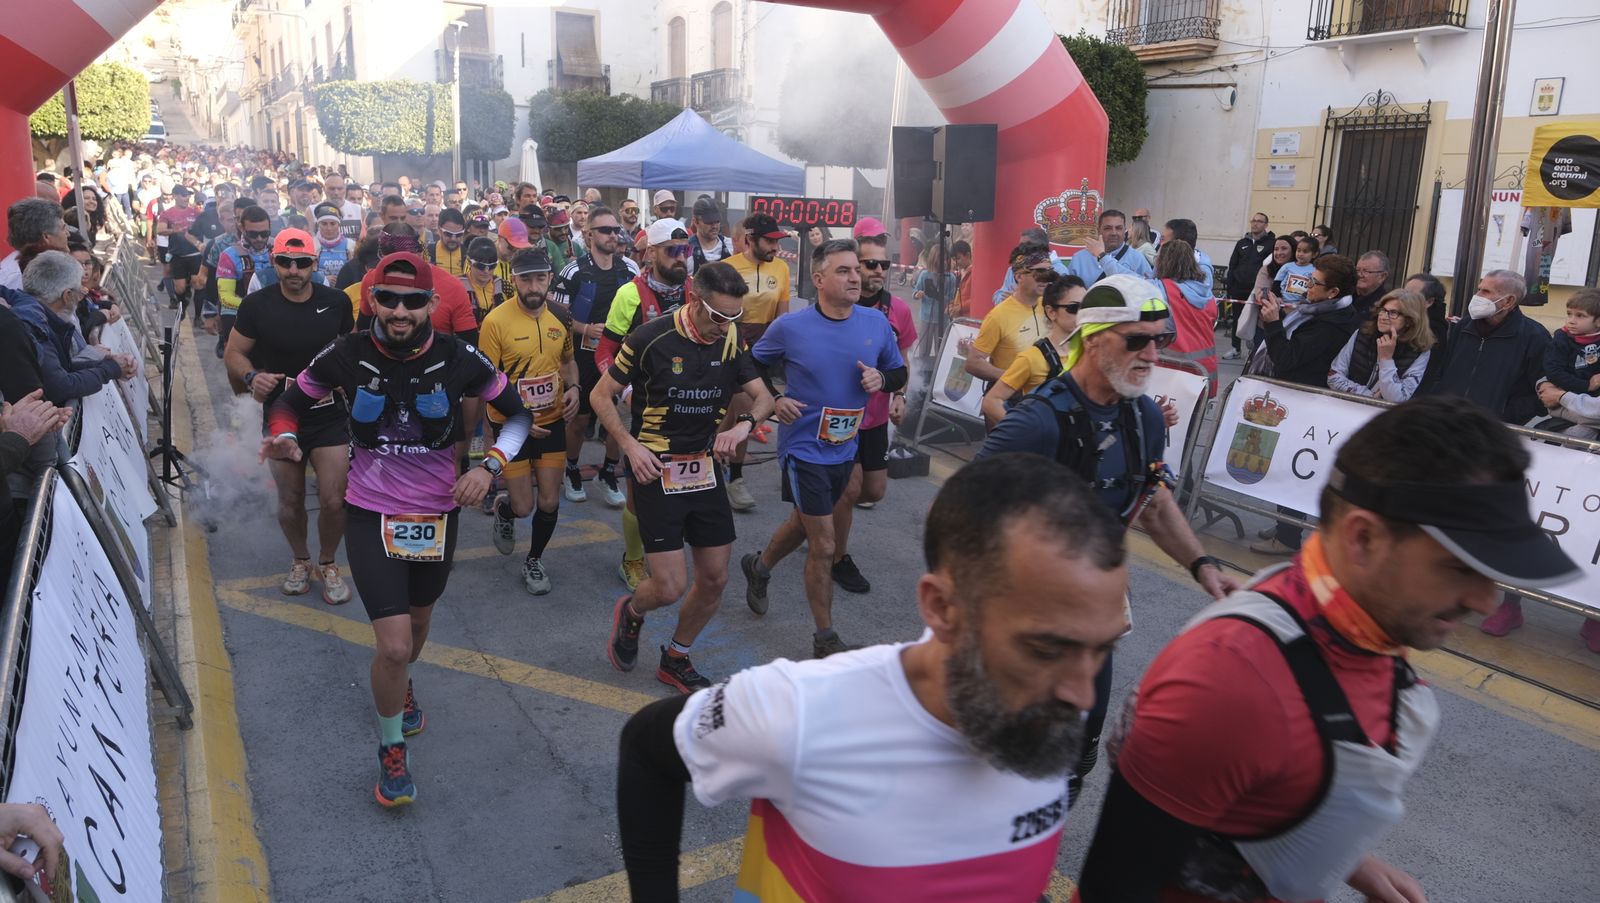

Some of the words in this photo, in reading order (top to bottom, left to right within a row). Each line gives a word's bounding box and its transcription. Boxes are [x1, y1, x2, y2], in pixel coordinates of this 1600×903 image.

[1553, 164, 1580, 172] entre
[1551, 172, 1587, 180] cienmil
[1549, 179, 1567, 188] .org
[754, 198, 854, 225] 00:00:08
[527, 382, 553, 396] 103
[668, 386, 722, 400] Cantoria
[674, 403, 713, 415] Runners
[829, 417, 857, 429] 214
[677, 461, 700, 475] 70
[394, 525, 436, 540] 230
